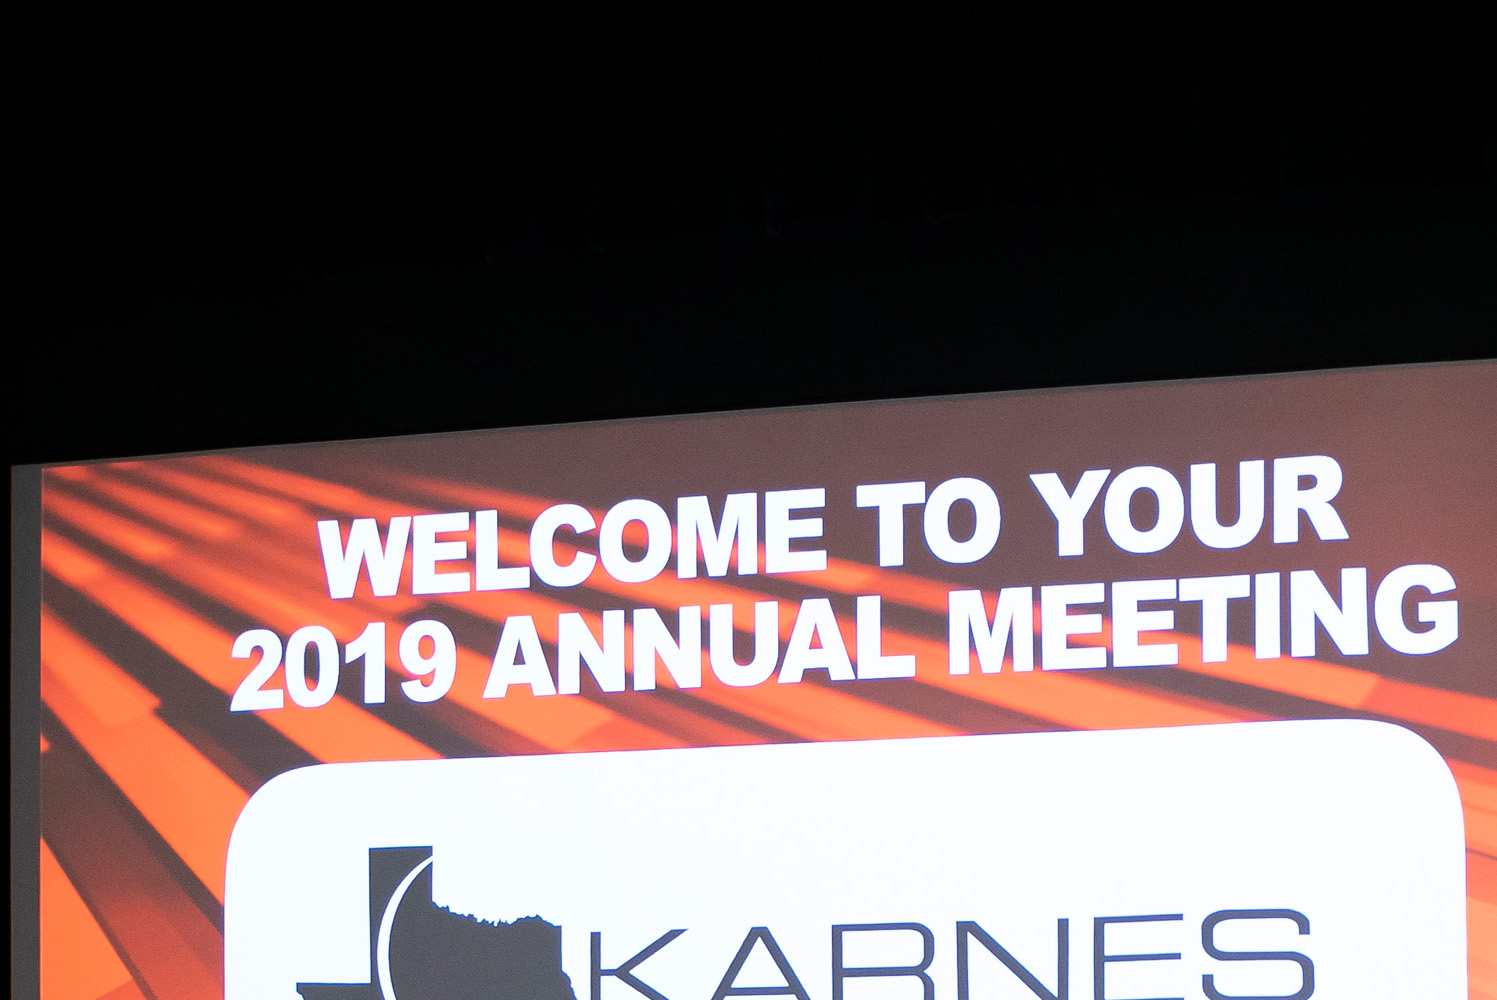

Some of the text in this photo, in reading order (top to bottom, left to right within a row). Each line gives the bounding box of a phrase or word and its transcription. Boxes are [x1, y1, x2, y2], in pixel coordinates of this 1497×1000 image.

[316, 453, 1350, 600] WELCOME TO YOUR
[229, 562, 1460, 713] 2019 ANNUAL MEETING
